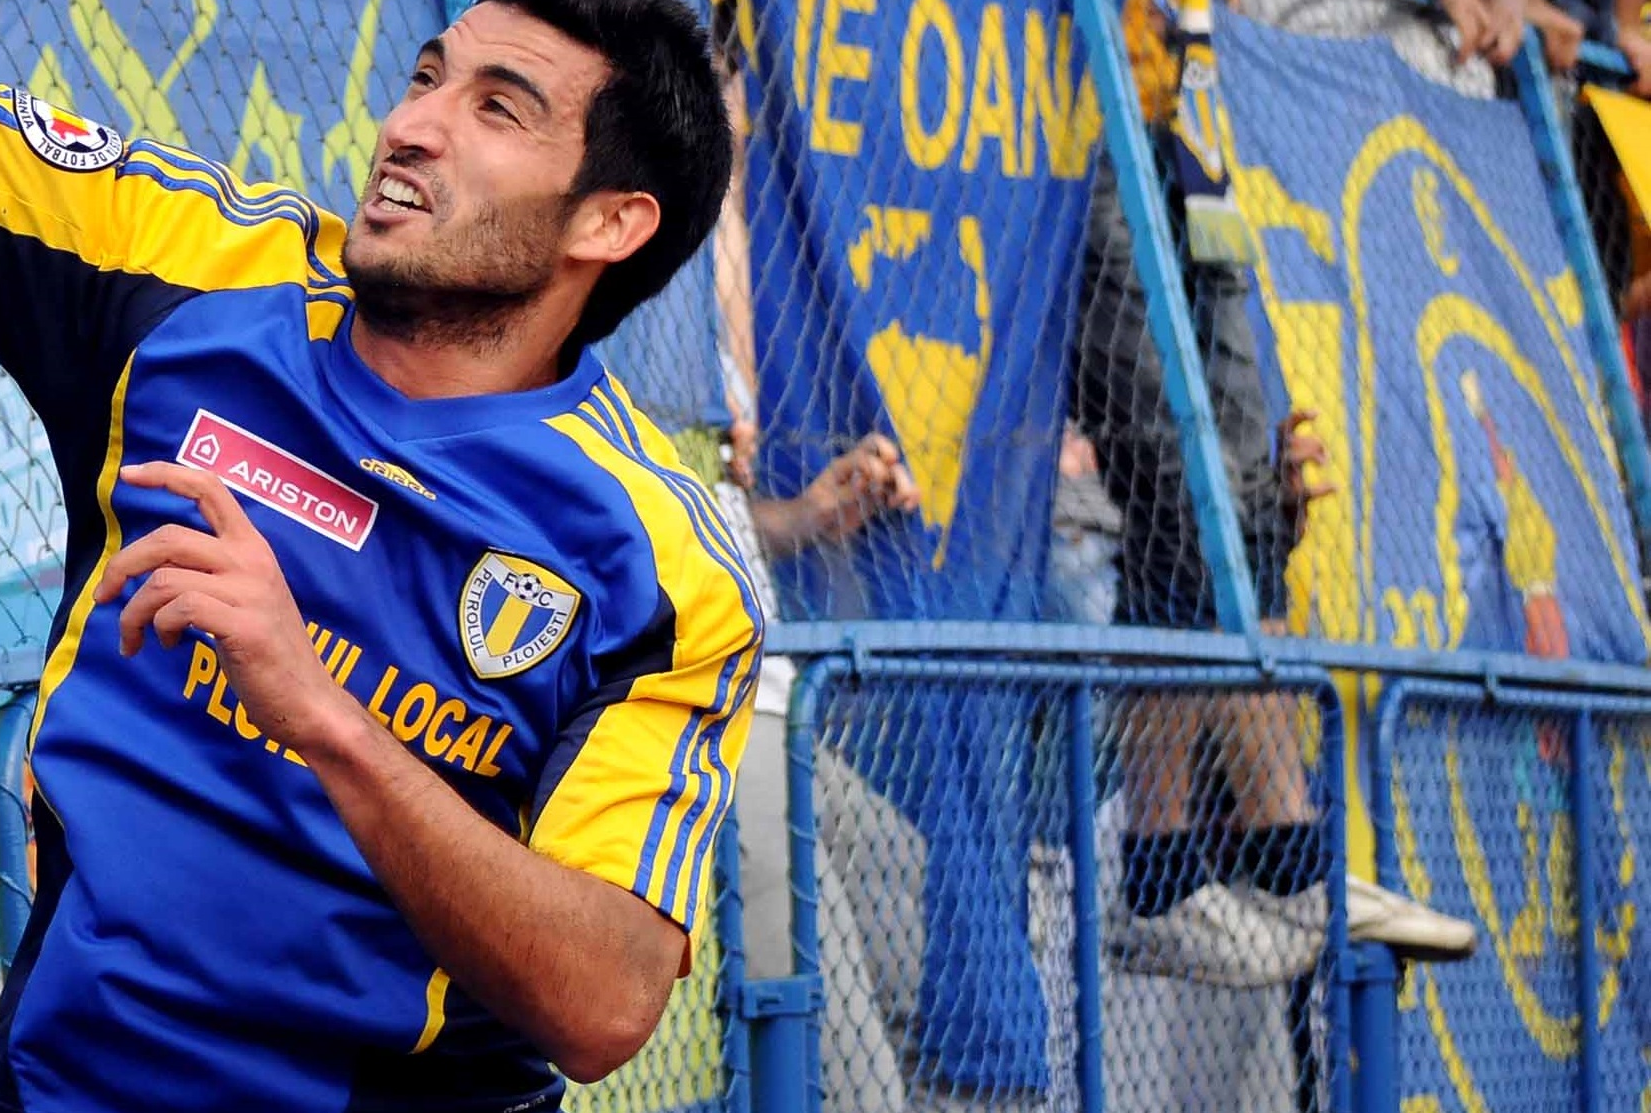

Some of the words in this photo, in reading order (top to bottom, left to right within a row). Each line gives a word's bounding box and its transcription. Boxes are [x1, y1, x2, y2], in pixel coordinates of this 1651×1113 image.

[36, 137, 87, 167] FOTBAL
[90, 151, 108, 166] DE
[227, 460, 358, 534] ARISTON
[359, 458, 437, 501] adidas
[466, 567, 493, 657] PETROLUL
[502, 611, 568, 668] PLOIESTI
[367, 665, 514, 777] LOCAL
